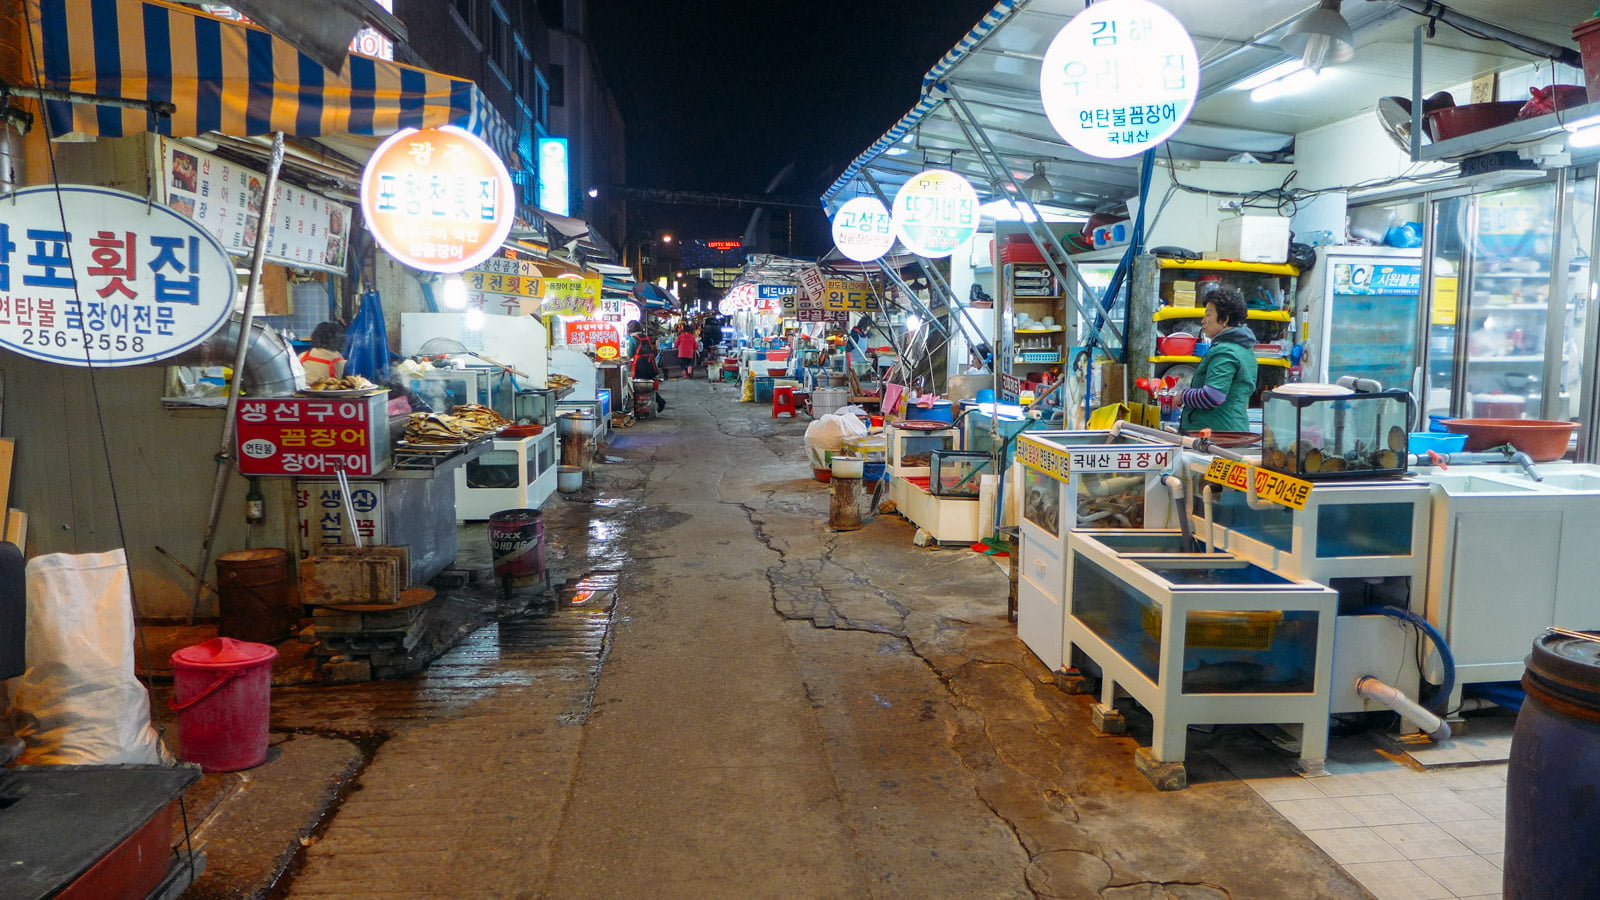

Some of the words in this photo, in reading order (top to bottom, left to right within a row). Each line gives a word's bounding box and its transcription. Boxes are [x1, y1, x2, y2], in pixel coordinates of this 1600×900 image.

[1107, 130, 1150, 144] 국내산
[839, 211, 891, 234] 고성집
[828, 291, 880, 309] 완도집
[22, 328, 144, 353] 256-2558
[240, 403, 364, 422] 생선구이
[280, 428, 365, 448] 꼼장어
[245, 443, 272, 455] 연탄불
[281, 453, 367, 473] 장어구이
[1073, 453, 1110, 469] 국내산
[1116, 451, 1169, 470] 꼼장어
[493, 529, 522, 539] Kixx
